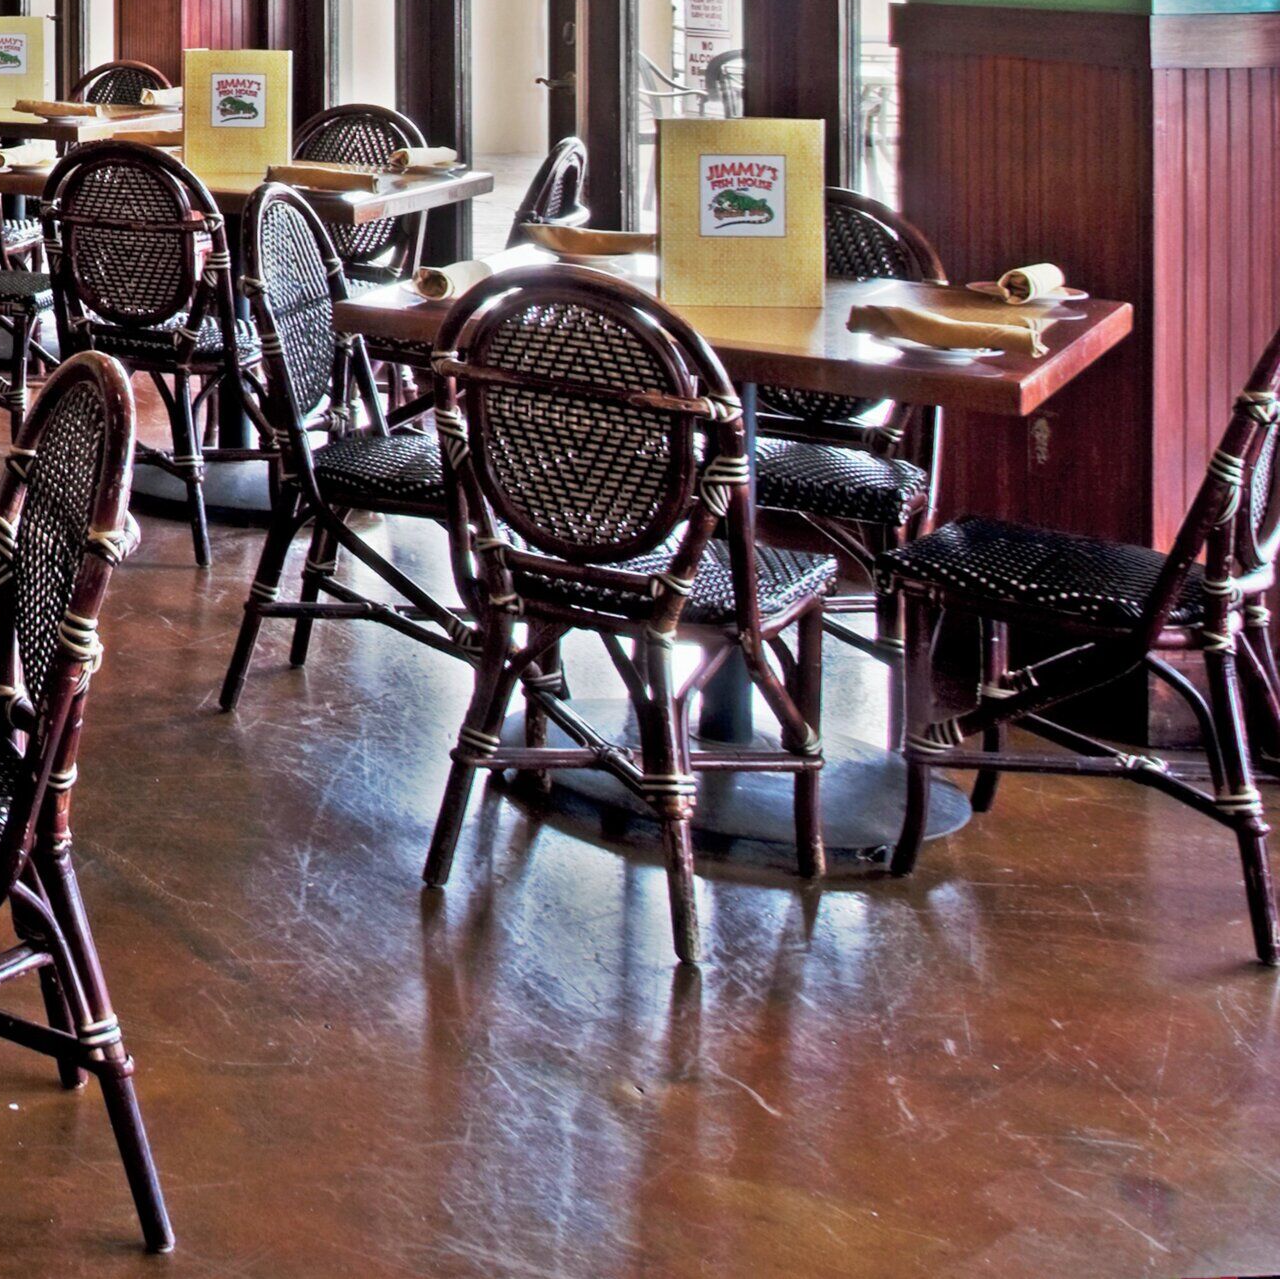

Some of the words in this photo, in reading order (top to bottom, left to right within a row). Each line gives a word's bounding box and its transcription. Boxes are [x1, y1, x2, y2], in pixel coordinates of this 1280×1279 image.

[216, 78, 261, 91] JIMMY'S
[706, 162, 778, 181] JIMMY'S
[710, 177, 734, 190] FISH
[737, 177, 773, 191] HOUSE
